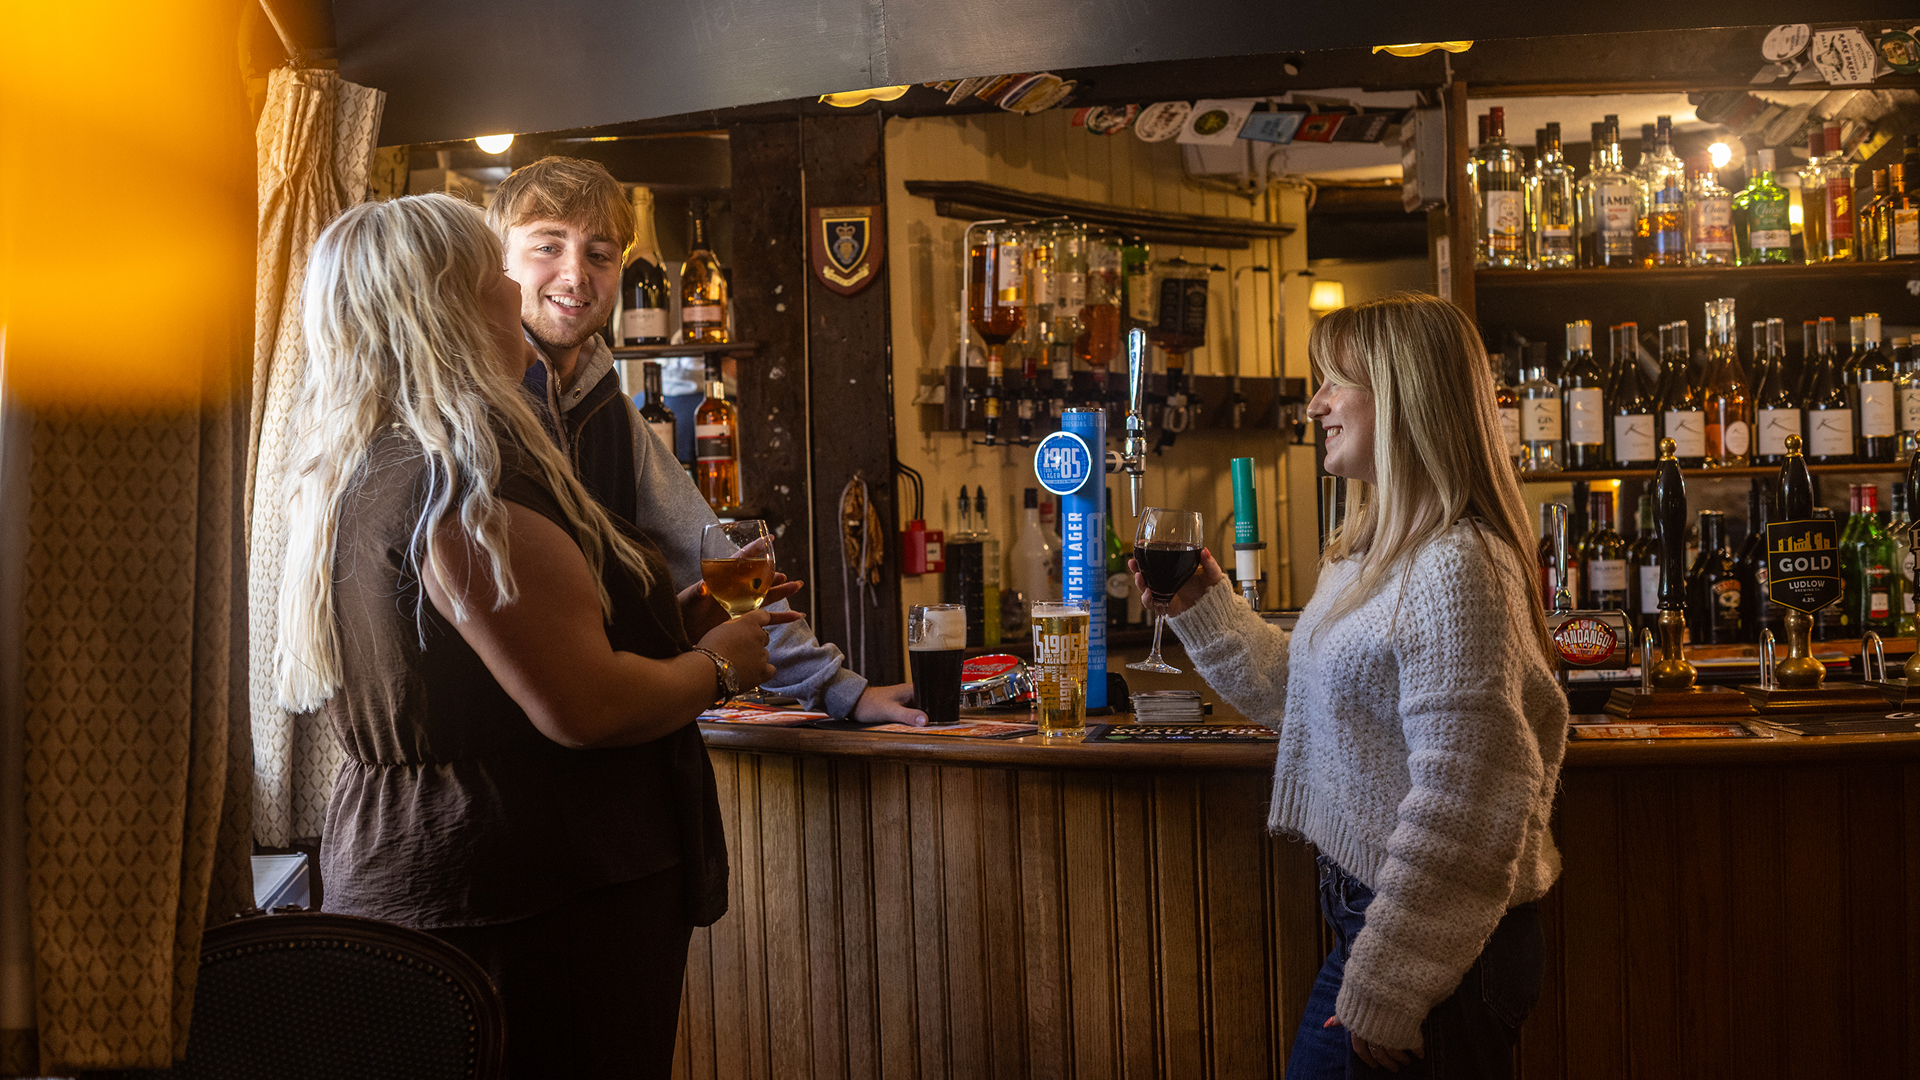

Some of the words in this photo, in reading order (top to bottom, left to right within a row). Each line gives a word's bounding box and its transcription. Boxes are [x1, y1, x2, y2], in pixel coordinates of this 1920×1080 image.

[1838, 33, 1849, 54] RARE
[1845, 55, 1858, 81] BREED
[1830, 70, 1838, 82] ALE
[1043, 448, 1080, 478] 1985
[1068, 513, 1083, 560] LAGER
[1779, 555, 1832, 573] GOLD
[1068, 566, 1083, 602] TISH
[1788, 580, 1826, 590] LUDLOW
[1043, 635, 1078, 664] 1985
[1555, 629, 1614, 650] FANDANGO!
